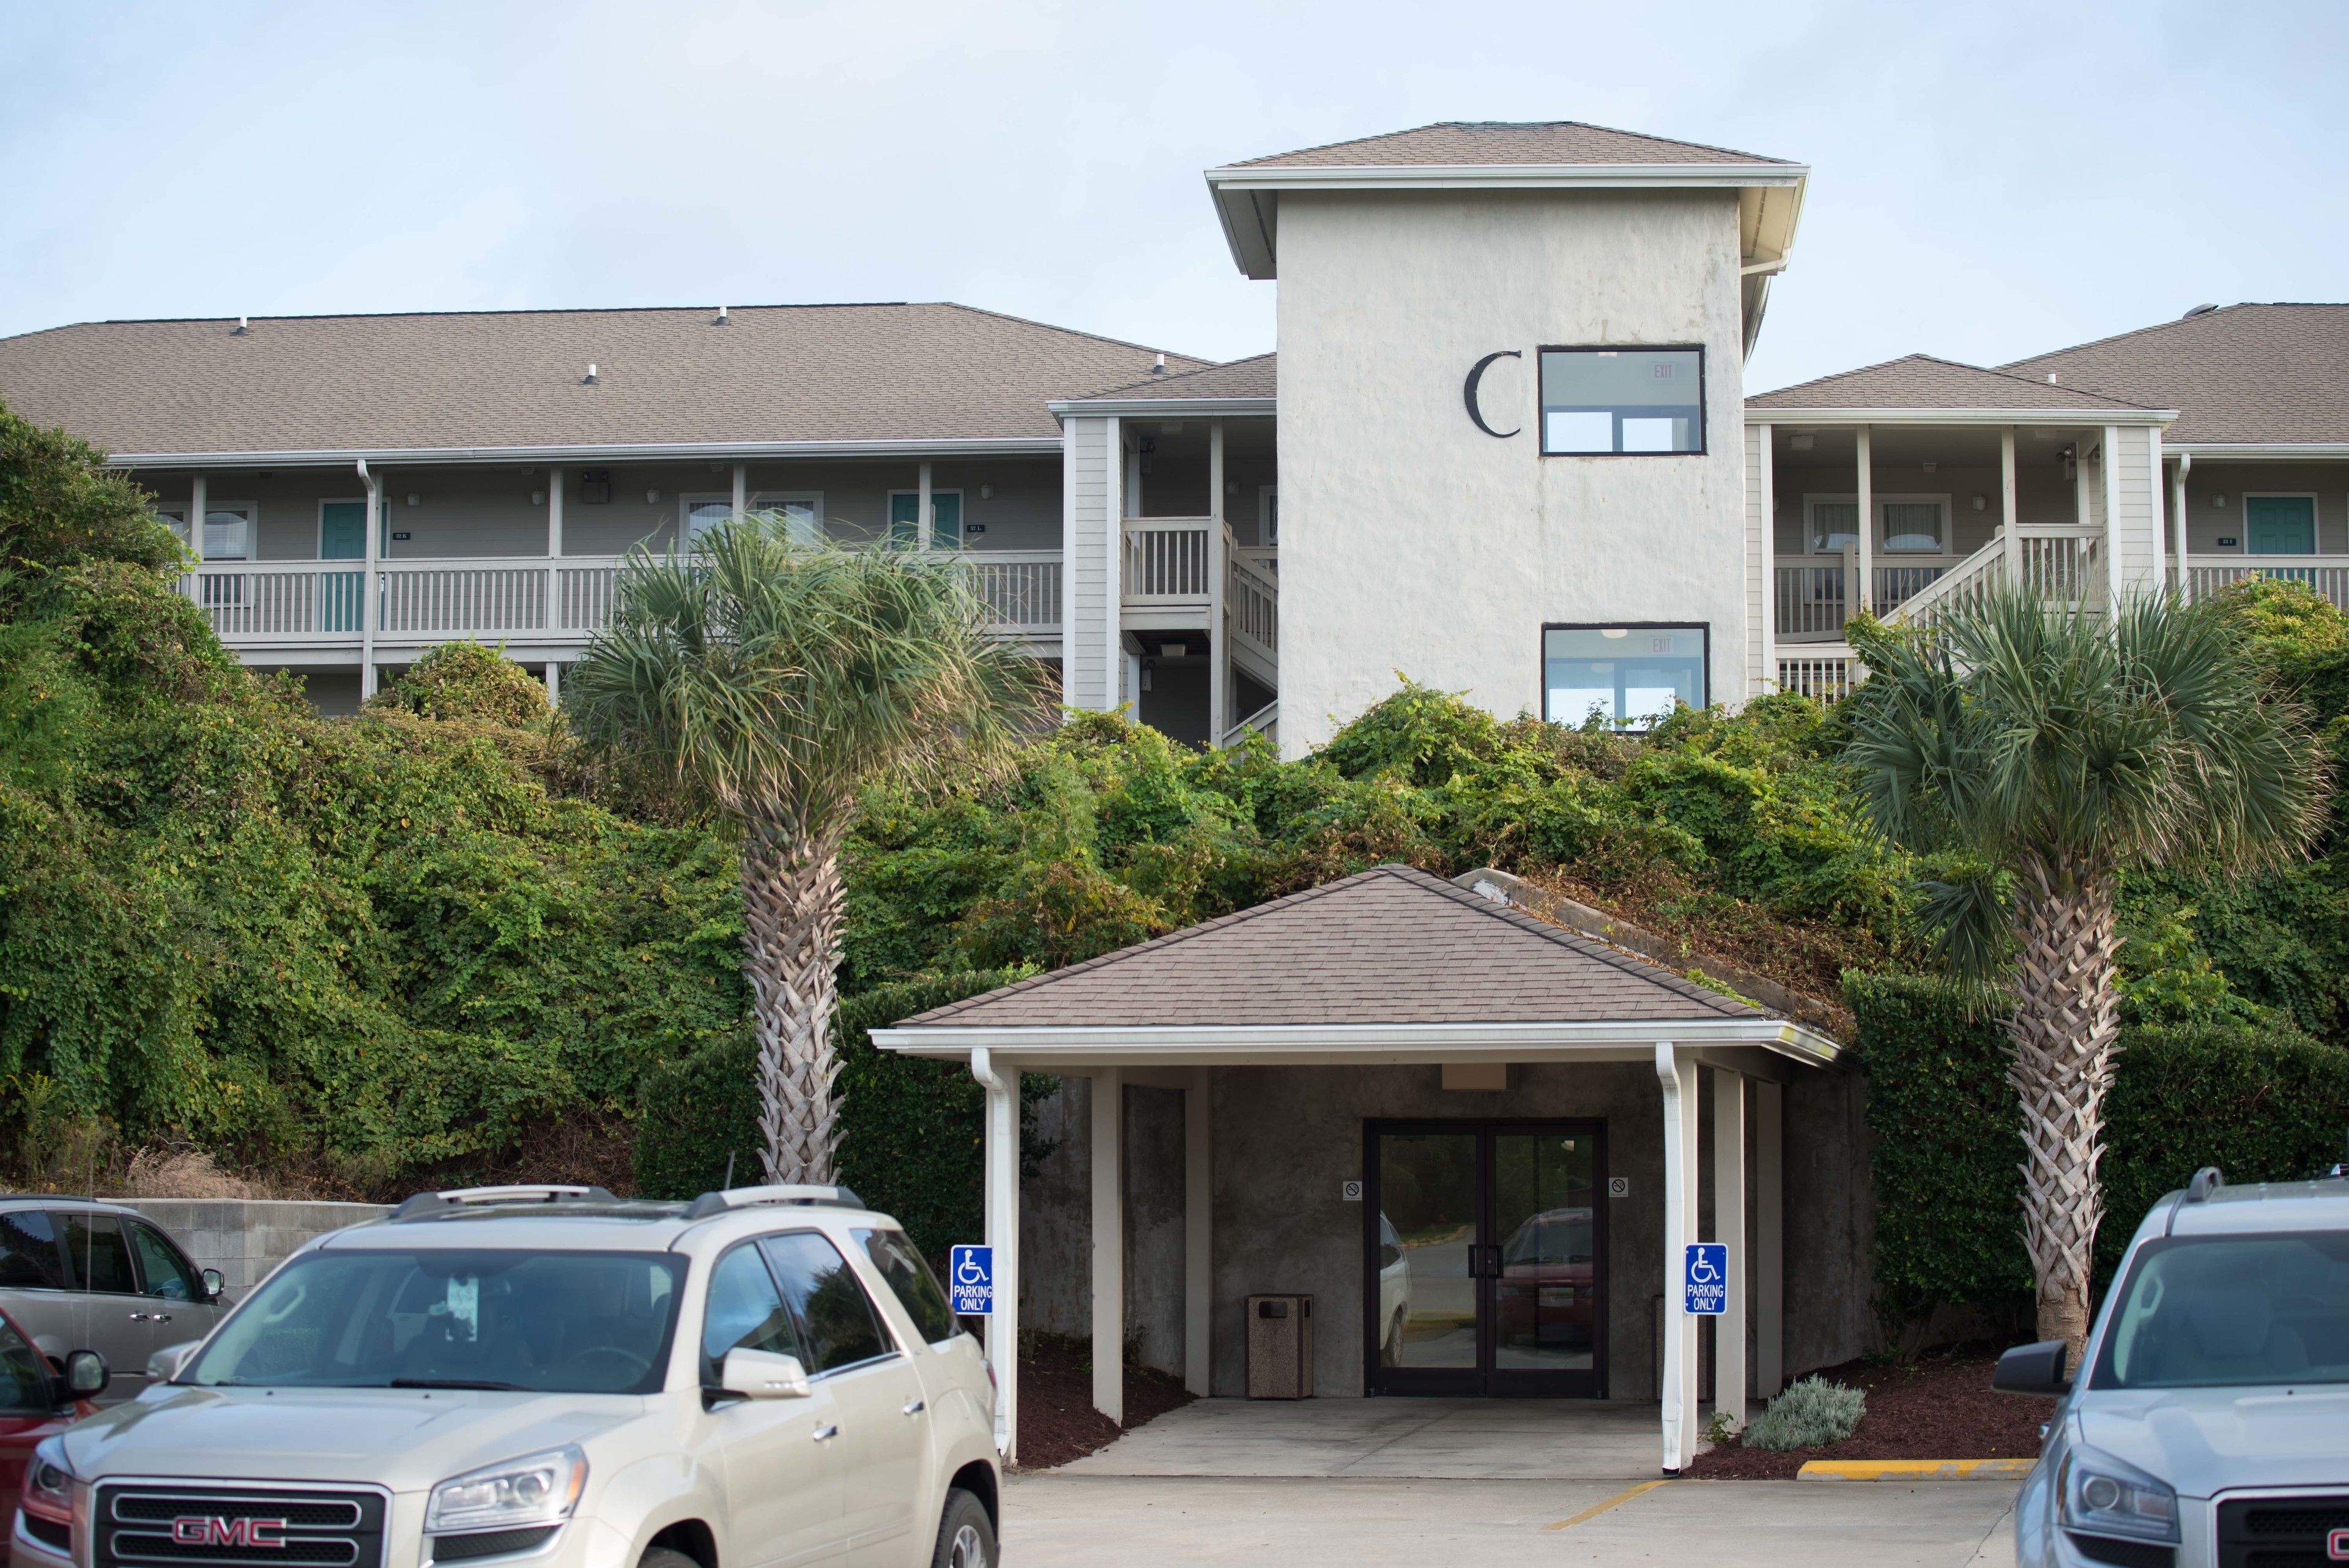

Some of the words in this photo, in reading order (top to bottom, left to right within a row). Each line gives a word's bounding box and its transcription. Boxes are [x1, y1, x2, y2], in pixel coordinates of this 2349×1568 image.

[1654, 364, 1673, 378] EXIT
[1464, 350, 1522, 438] C
[1653, 638, 1671, 653] EXIT
[954, 1285, 992, 1298] PARKING
[1687, 1284, 1724, 1298] PARKING
[960, 1298, 985, 1310] ONLY
[1693, 1297, 1717, 1310] ONLY
[173, 1515, 287, 1547] GMC
